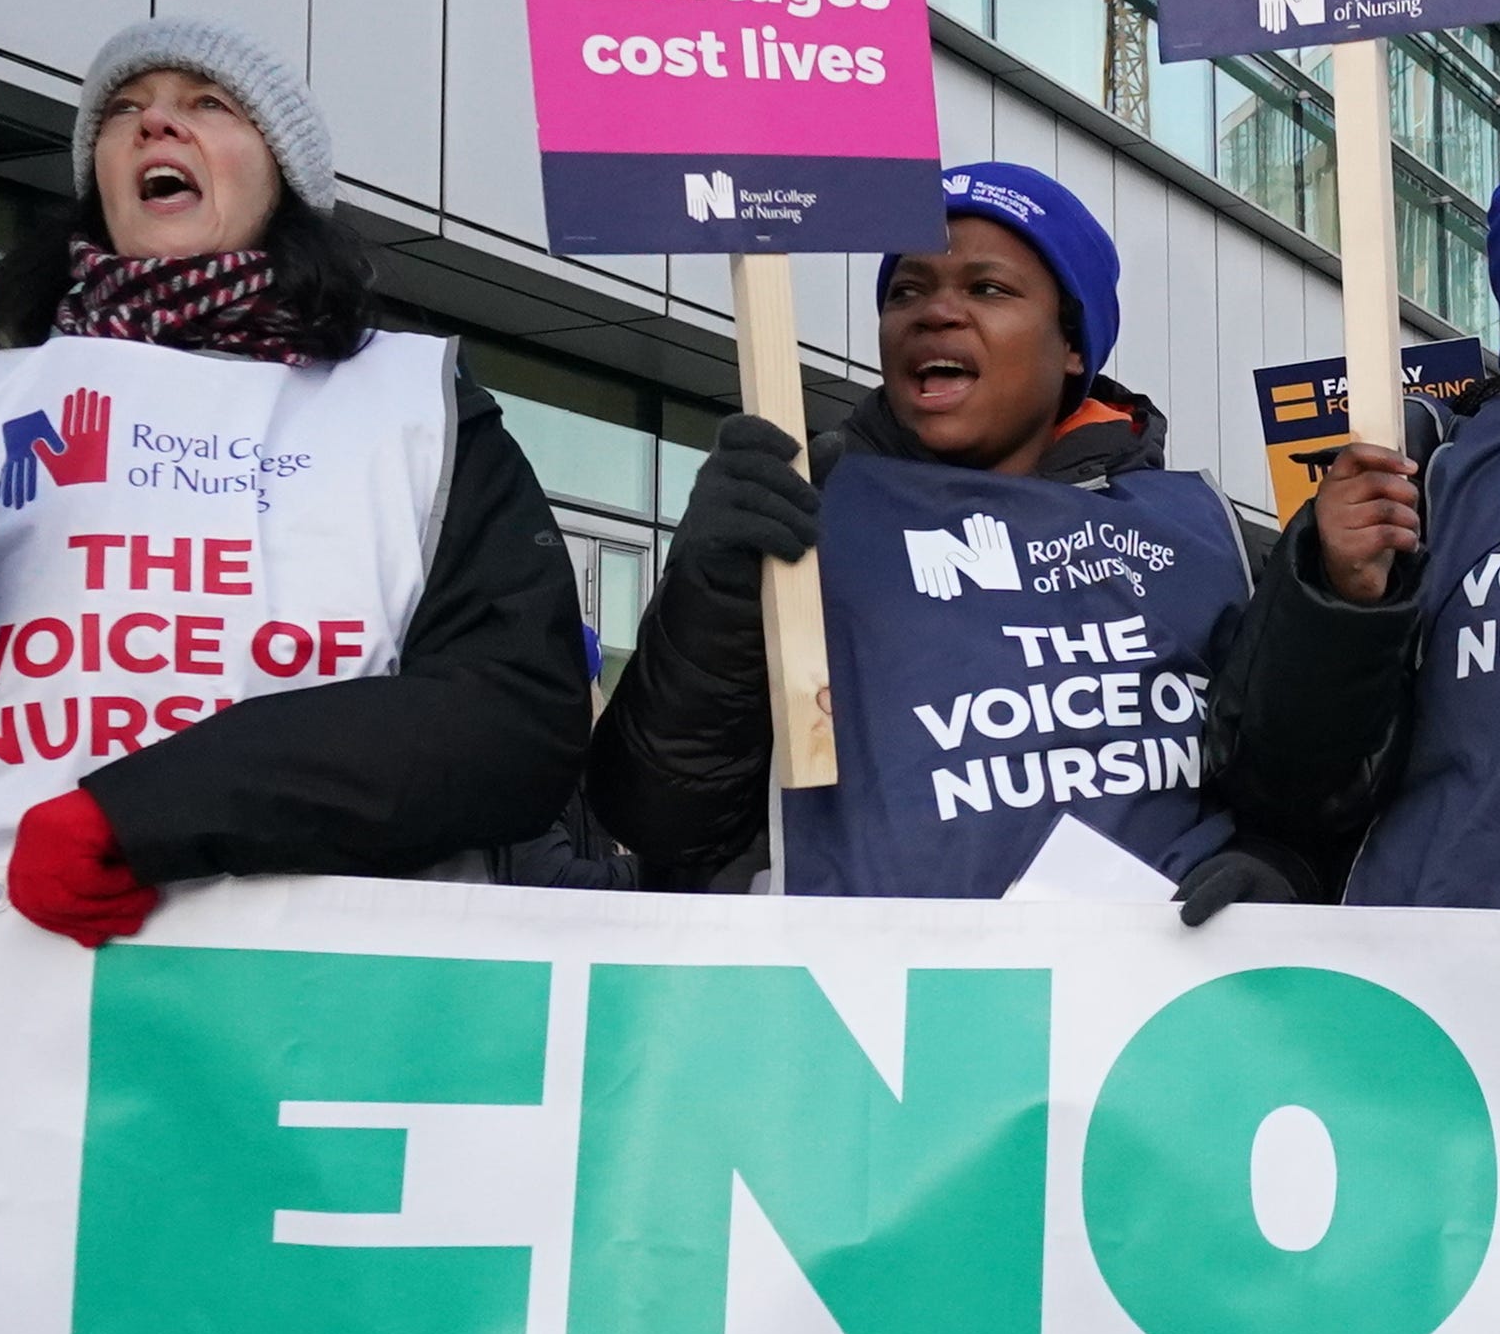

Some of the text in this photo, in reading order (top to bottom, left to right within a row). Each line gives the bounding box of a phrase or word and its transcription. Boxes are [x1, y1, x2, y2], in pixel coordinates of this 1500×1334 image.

[1333, 0, 1354, 21] of
[581, 24, 887, 85] cost lives
[739, 189, 818, 209] Royal College
[741, 205, 803, 223] of Nursing
[132, 423, 218, 463] Royal
[128, 461, 164, 488] of
[67, 533, 254, 596] THE
[1026, 520, 1176, 572] Royal College
[1033, 568, 1061, 594] of
[251, 619, 366, 679] OF
[1002, 614, 1157, 668] THE
[912, 671, 1210, 751] VOICE OF
[930, 735, 1201, 821] NURSIN
